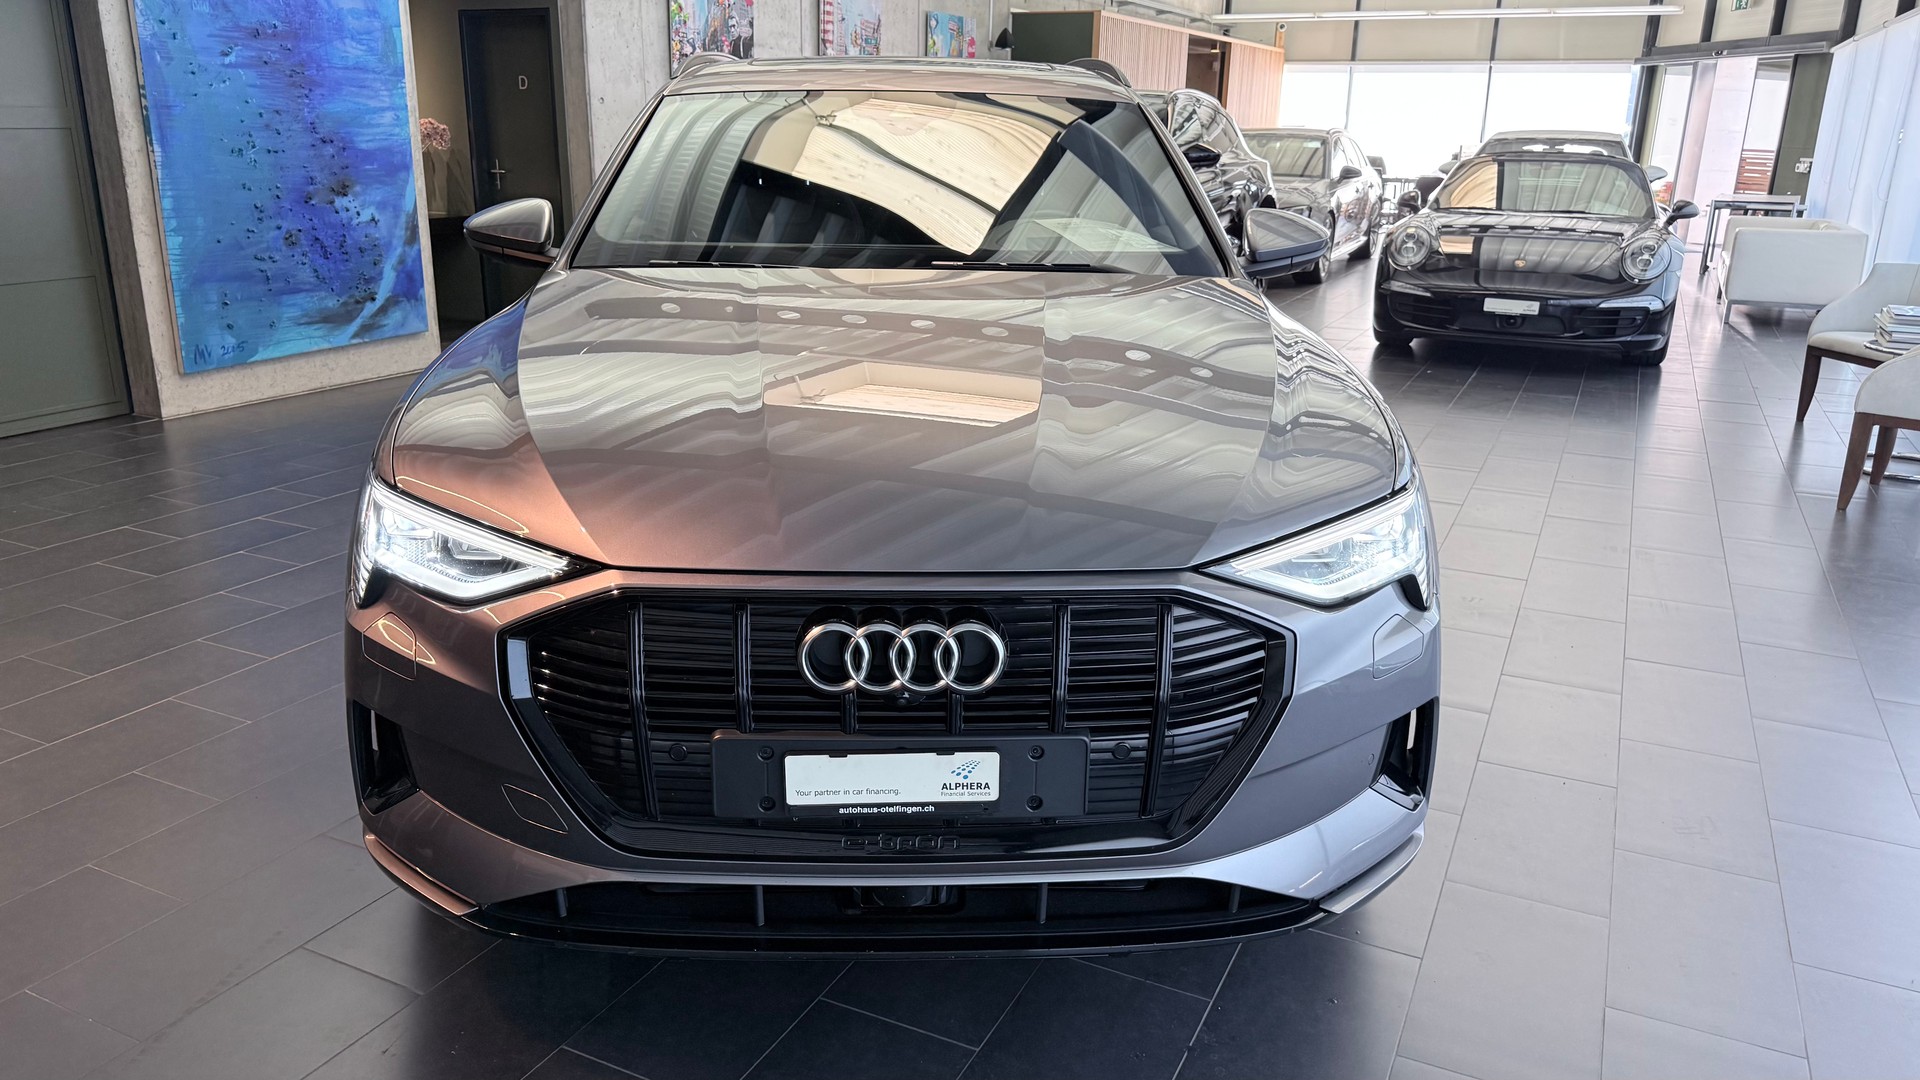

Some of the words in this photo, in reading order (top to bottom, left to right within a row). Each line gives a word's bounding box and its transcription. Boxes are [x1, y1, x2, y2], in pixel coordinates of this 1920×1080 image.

[518, 75, 528, 89] D
[941, 782, 991, 790] ALPHERA
[795, 789, 812, 797] Your
[814, 789, 841, 797] partner
[843, 788, 850, 796] in
[852, 788, 864, 796] car
[865, 787, 901, 796] financing.
[839, 804, 935, 814] autohaus-otelfingen.ch
